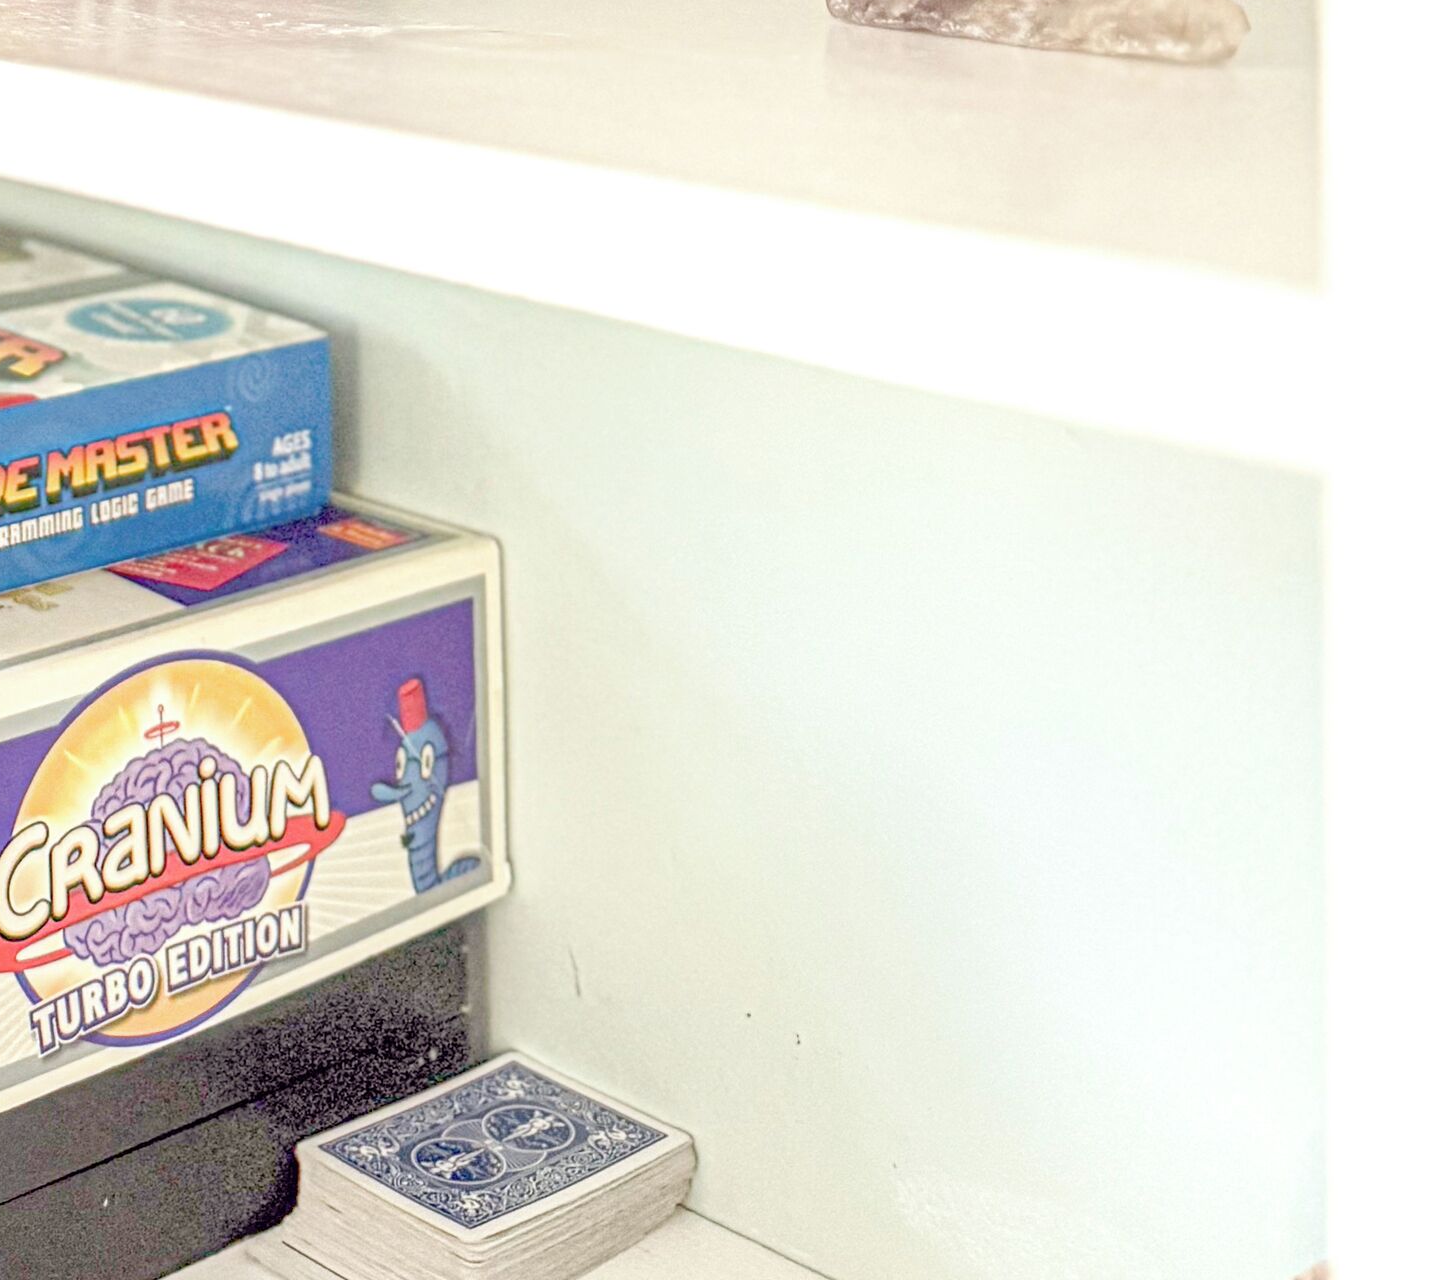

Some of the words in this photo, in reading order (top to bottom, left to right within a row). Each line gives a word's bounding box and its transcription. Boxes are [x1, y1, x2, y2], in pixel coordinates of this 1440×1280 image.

[46, 412, 240, 500] MASTER
[90, 491, 139, 524] LOGIC
[145, 477, 195, 511] GAME
[31, 957, 156, 1058] TURBO
[166, 908, 304, 996] EDITION
